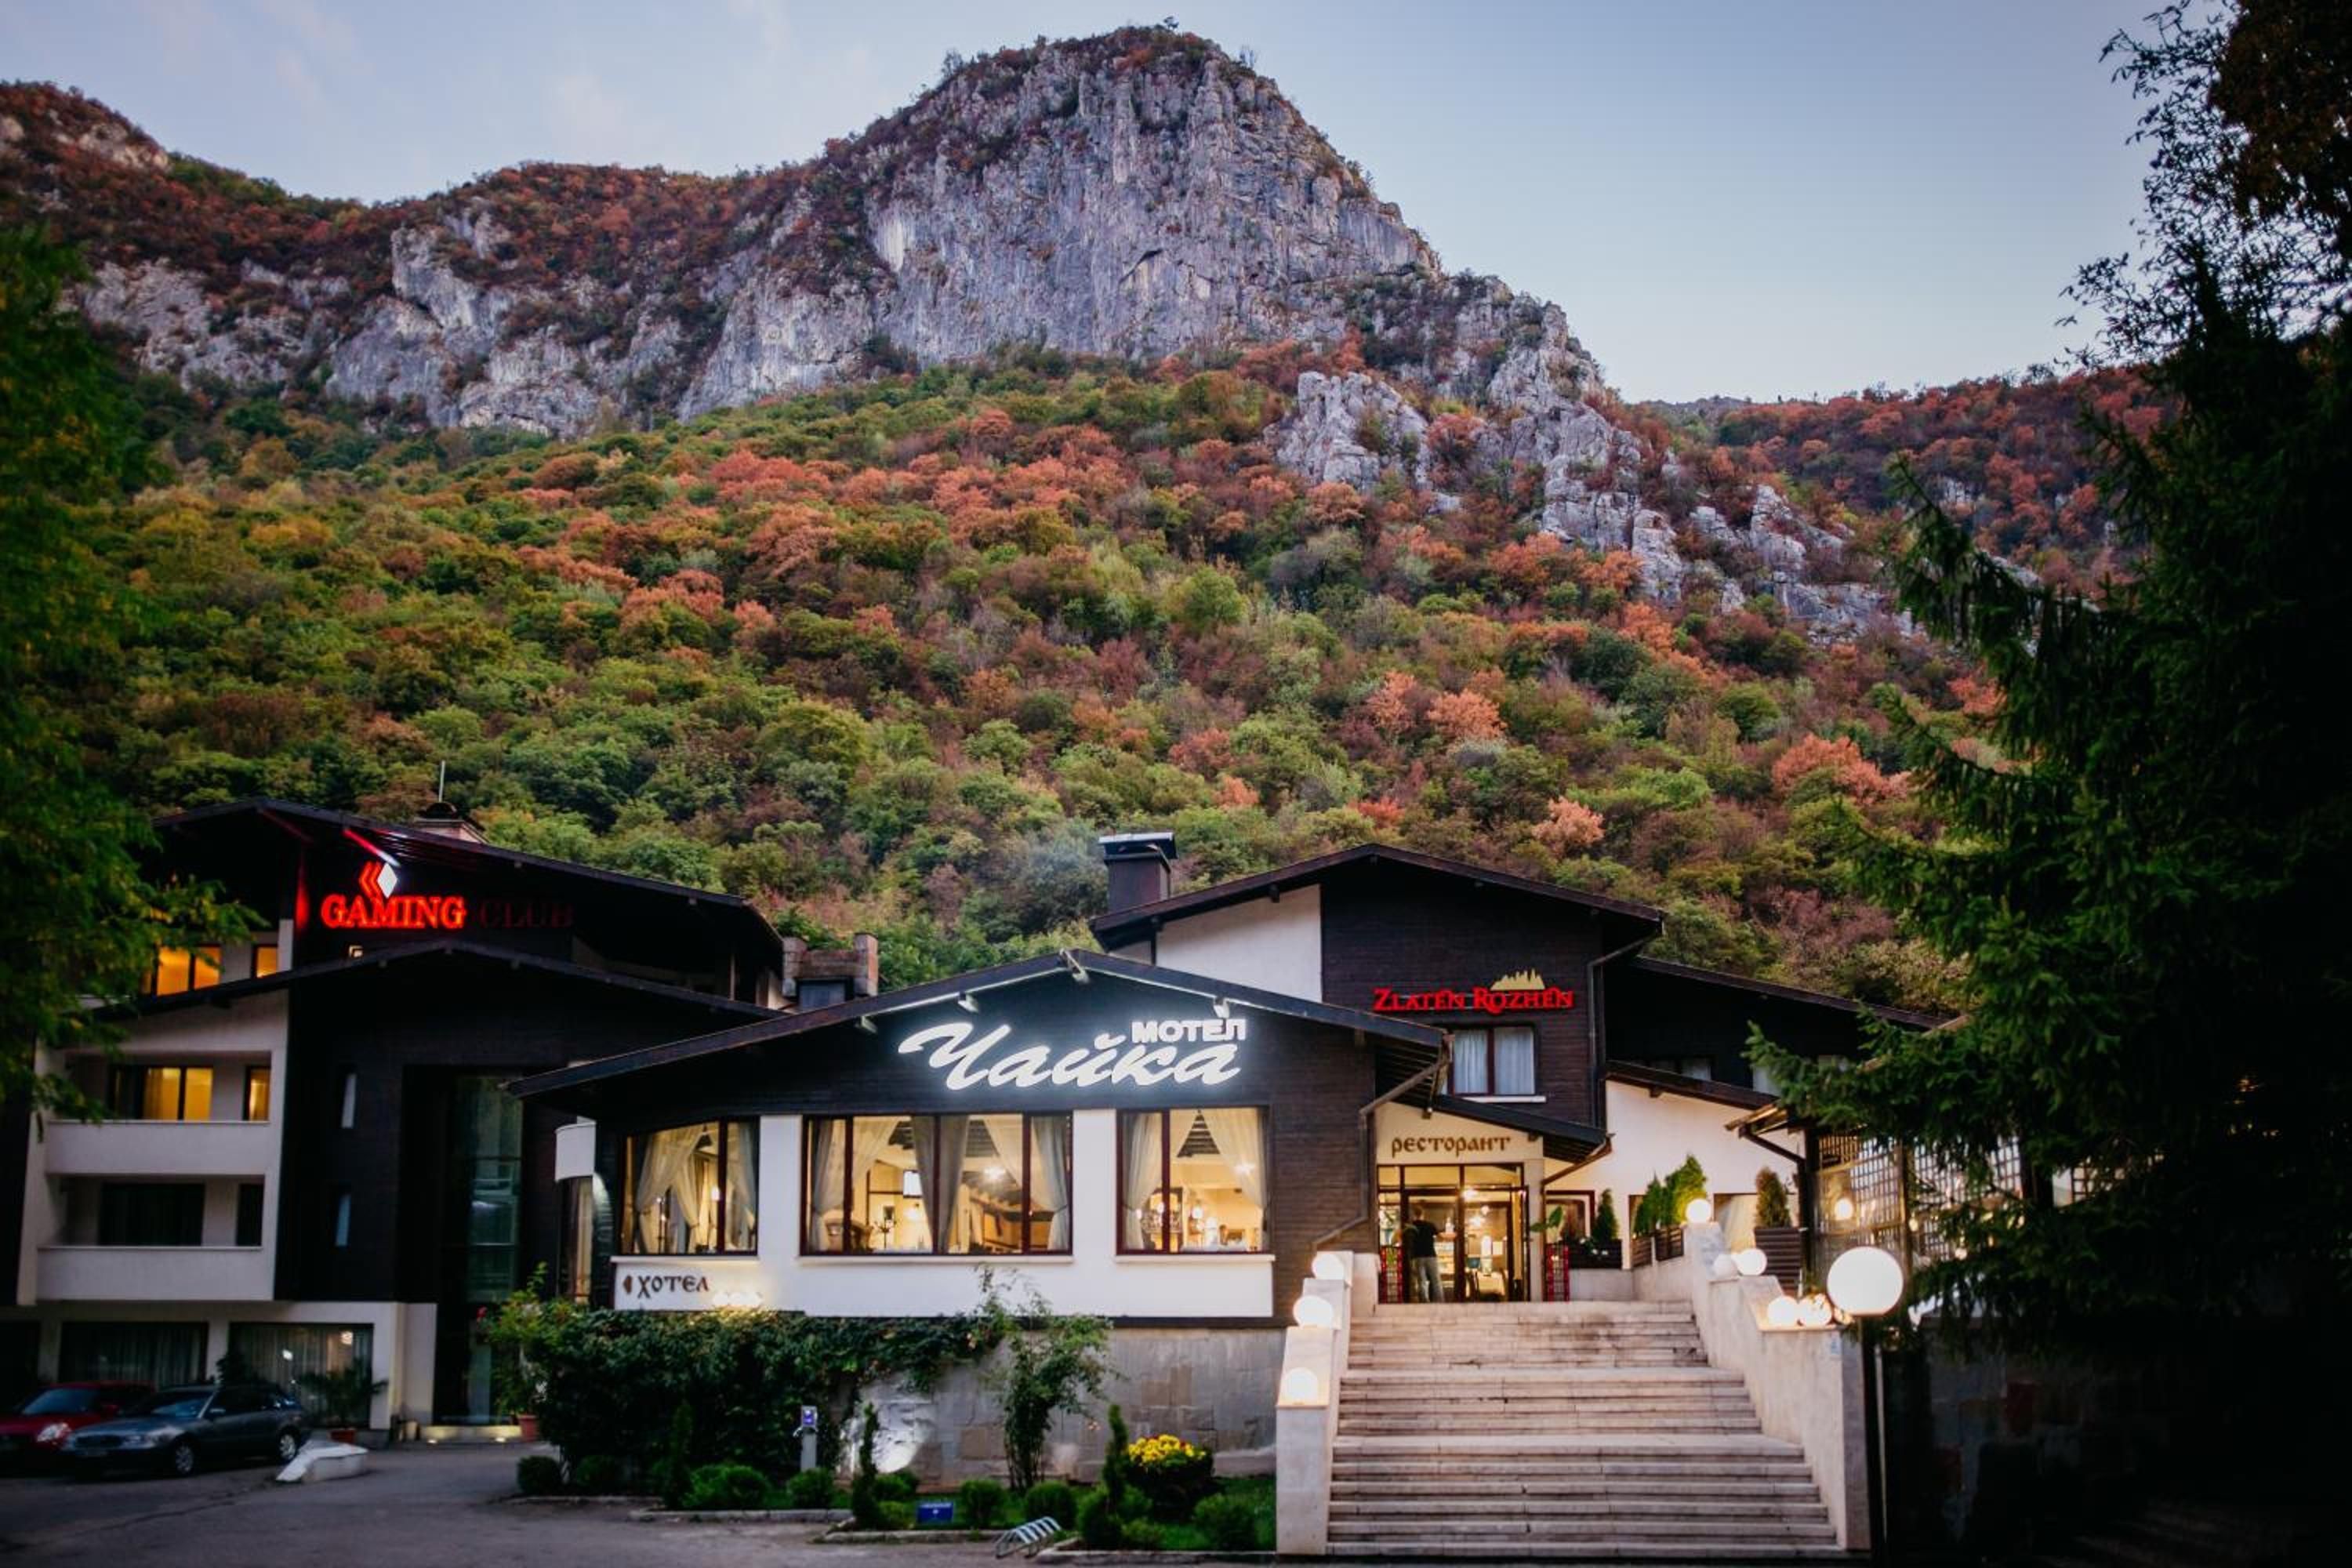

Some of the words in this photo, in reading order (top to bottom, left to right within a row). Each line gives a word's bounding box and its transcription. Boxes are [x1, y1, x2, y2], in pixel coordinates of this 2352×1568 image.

[320, 894, 466, 929] GAMING
[479, 898, 574, 928] CLUB
[1373, 986, 1465, 1011] ZLATEN
[1471, 985, 1574, 1015] ROZHEN
[1131, 1018, 1246, 1044] МОТЕЛ
[898, 1022, 1242, 1091] Чайка
